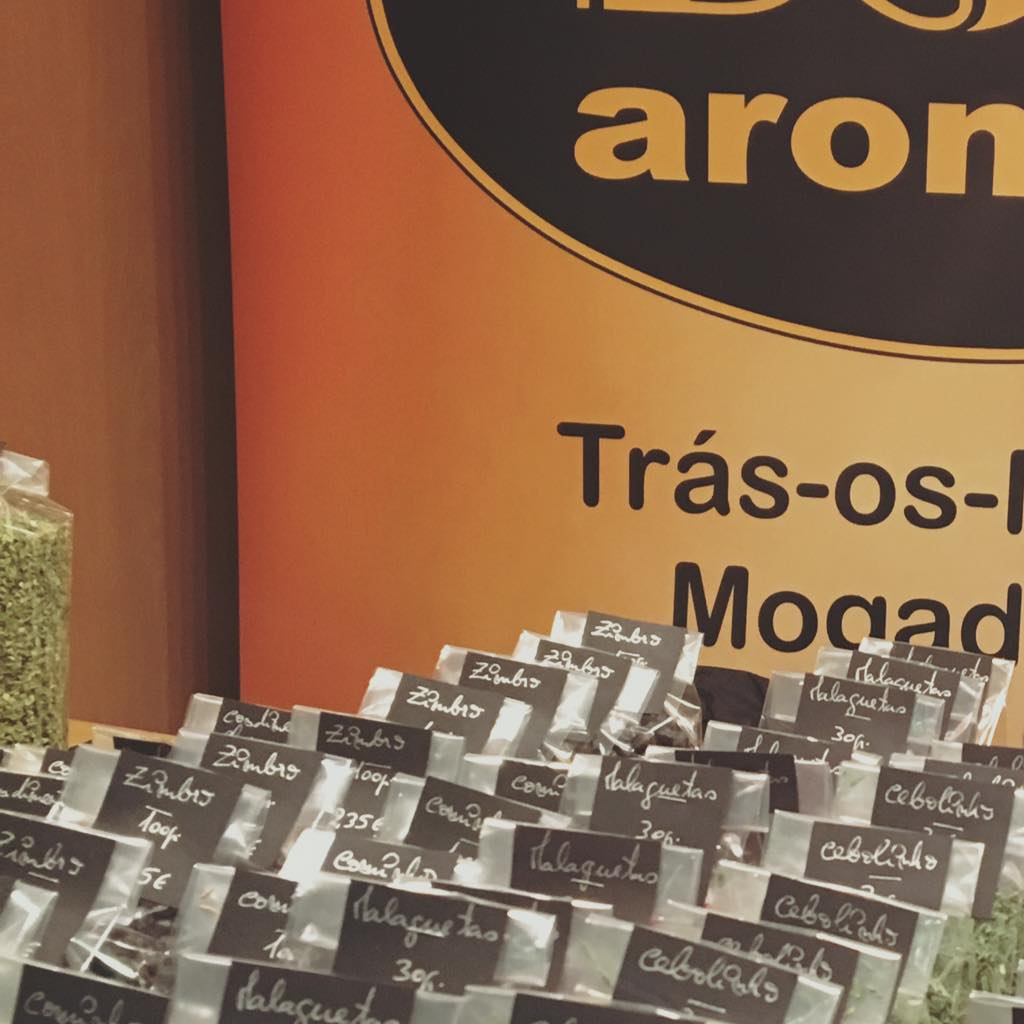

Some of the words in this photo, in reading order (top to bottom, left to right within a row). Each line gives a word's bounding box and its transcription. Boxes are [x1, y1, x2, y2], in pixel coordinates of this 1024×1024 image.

[468, 661, 542, 689] Zimbro
[406, 686, 485, 719] Zimbro
[325, 723, 407, 751] Zimbro
[213, 743, 302, 781] Zimbro
[122, 765, 216, 807] Zimbro
[604, 760, 718, 810] Malaguetas
[530, 830, 659, 892] Malaguetas
[352, 885, 500, 948] Malaguetas
[638, 945, 779, 1003] Cebolinho
